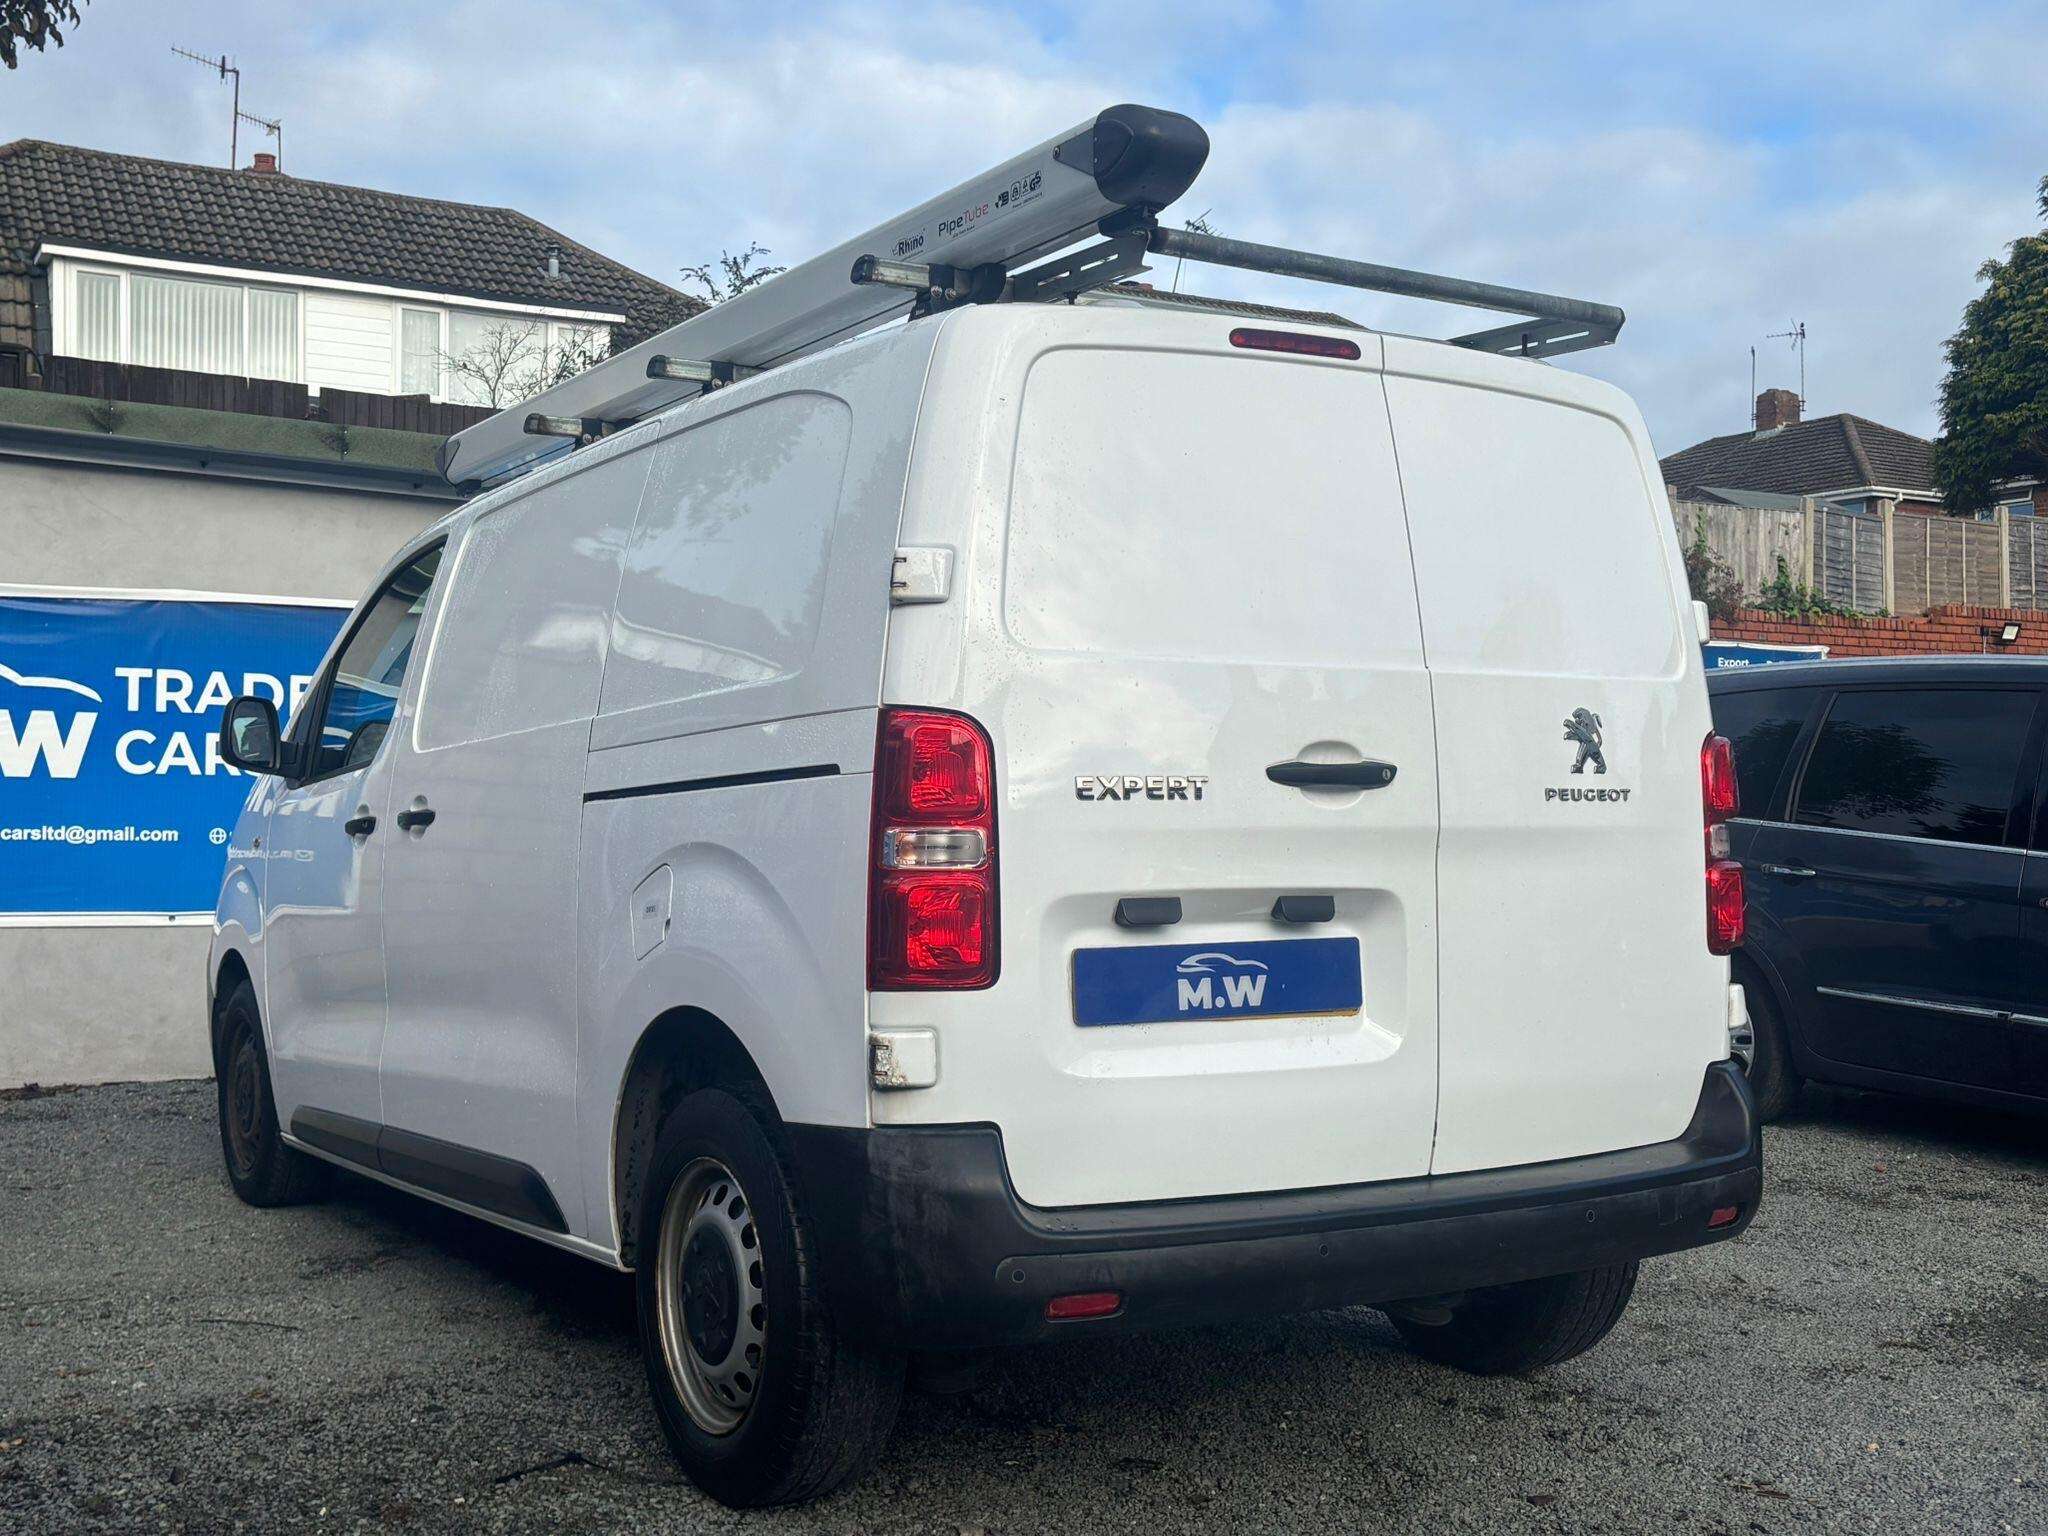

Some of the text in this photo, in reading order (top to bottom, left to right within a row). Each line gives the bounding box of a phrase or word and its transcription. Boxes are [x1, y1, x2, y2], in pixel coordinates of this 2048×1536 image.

[898, 234, 924, 256] Rhino
[115, 729, 259, 777] CAR
[1075, 775, 1209, 801] EXPERT
[1544, 787, 1631, 802] PEUGEOT
[1177, 974, 1267, 1011] M.W
